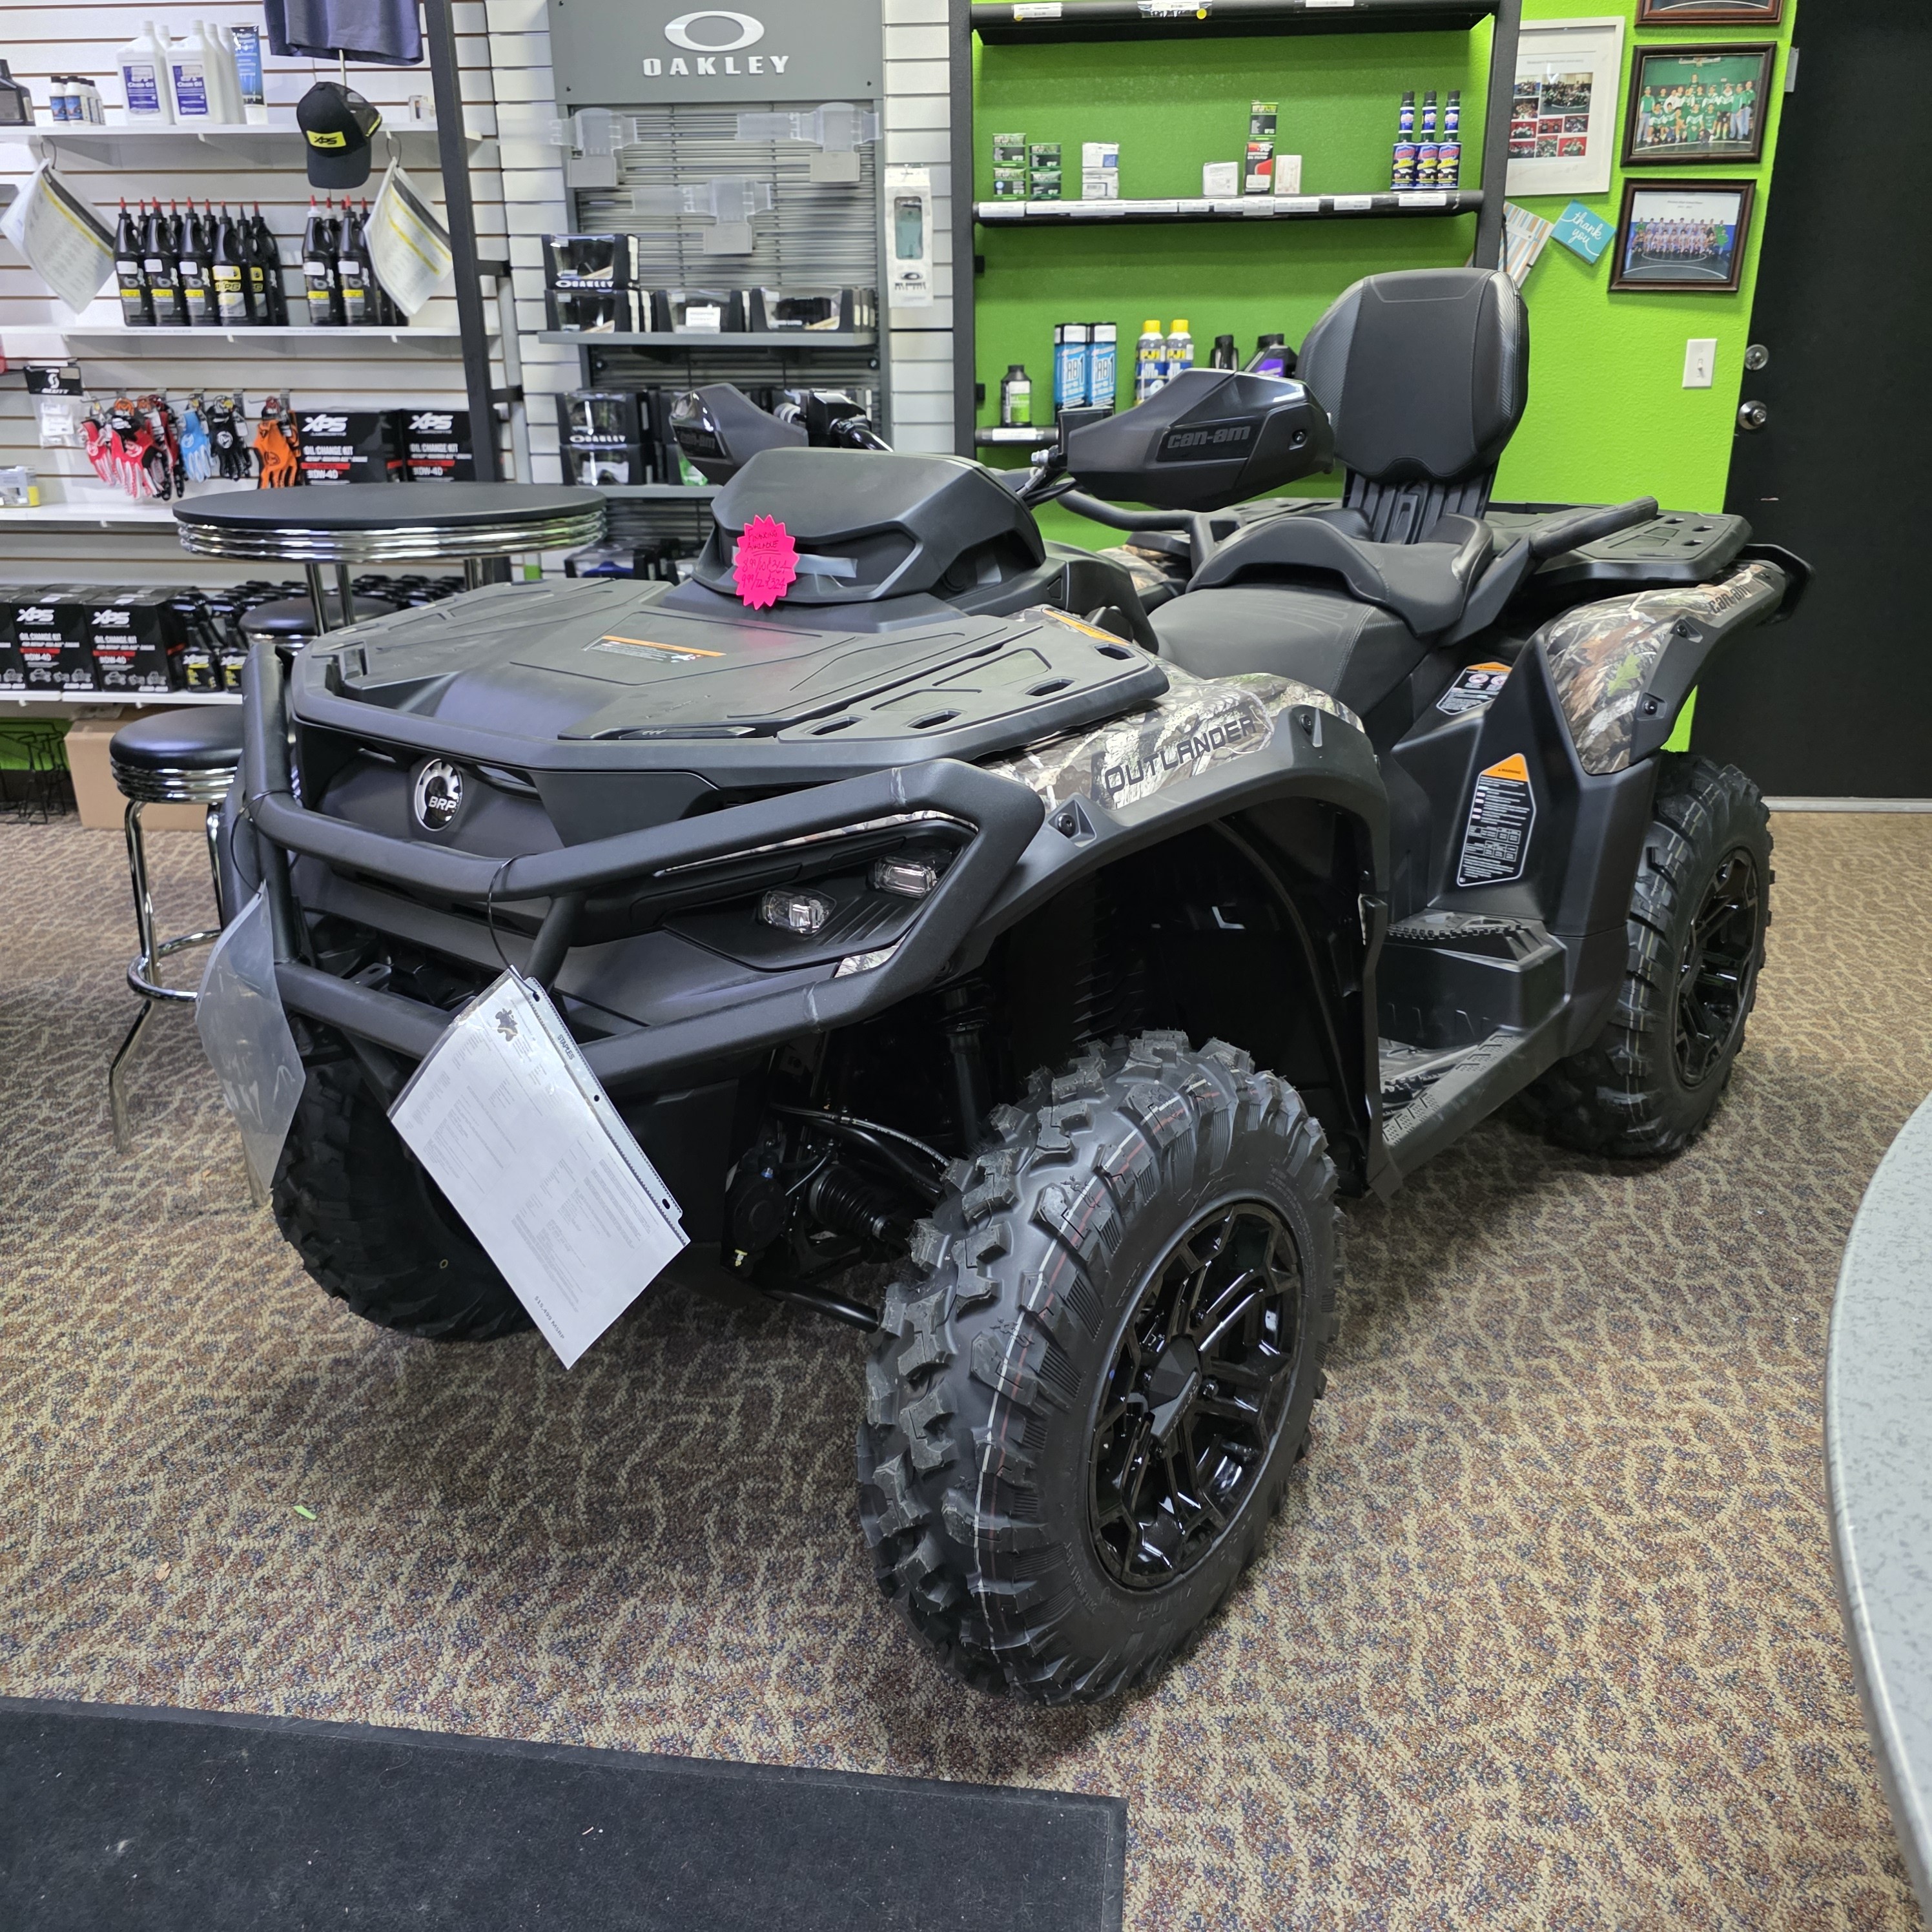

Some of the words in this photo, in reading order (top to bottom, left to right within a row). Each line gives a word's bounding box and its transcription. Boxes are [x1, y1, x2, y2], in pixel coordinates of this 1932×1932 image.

[643, 56, 789, 76] OAKLEY
[1560, 212, 1603, 240] thank
[1140, 349, 1160, 360] PJ1
[1167, 349, 1186, 360] PJ1
[302, 414, 348, 432] XPS
[408, 413, 453, 429] XPS
[1167, 426, 1251, 449] can-am
[303, 446, 315, 455] OIL
[315, 446, 342, 455] CHANGE
[343, 446, 353, 455] KIT
[1709, 584, 1752, 614] can-am
[16, 606, 55, 622] XPS
[91, 609, 130, 624] XPS
[182, 653, 209, 664] XPS
[1105, 715, 1257, 796] OUTLANDER
[428, 796, 457, 811] BRP
[557, 1034, 575, 1060] STAPLES
[534, 1295, 552, 1321] $15,499
[551, 1321, 564, 1339] MSRP
